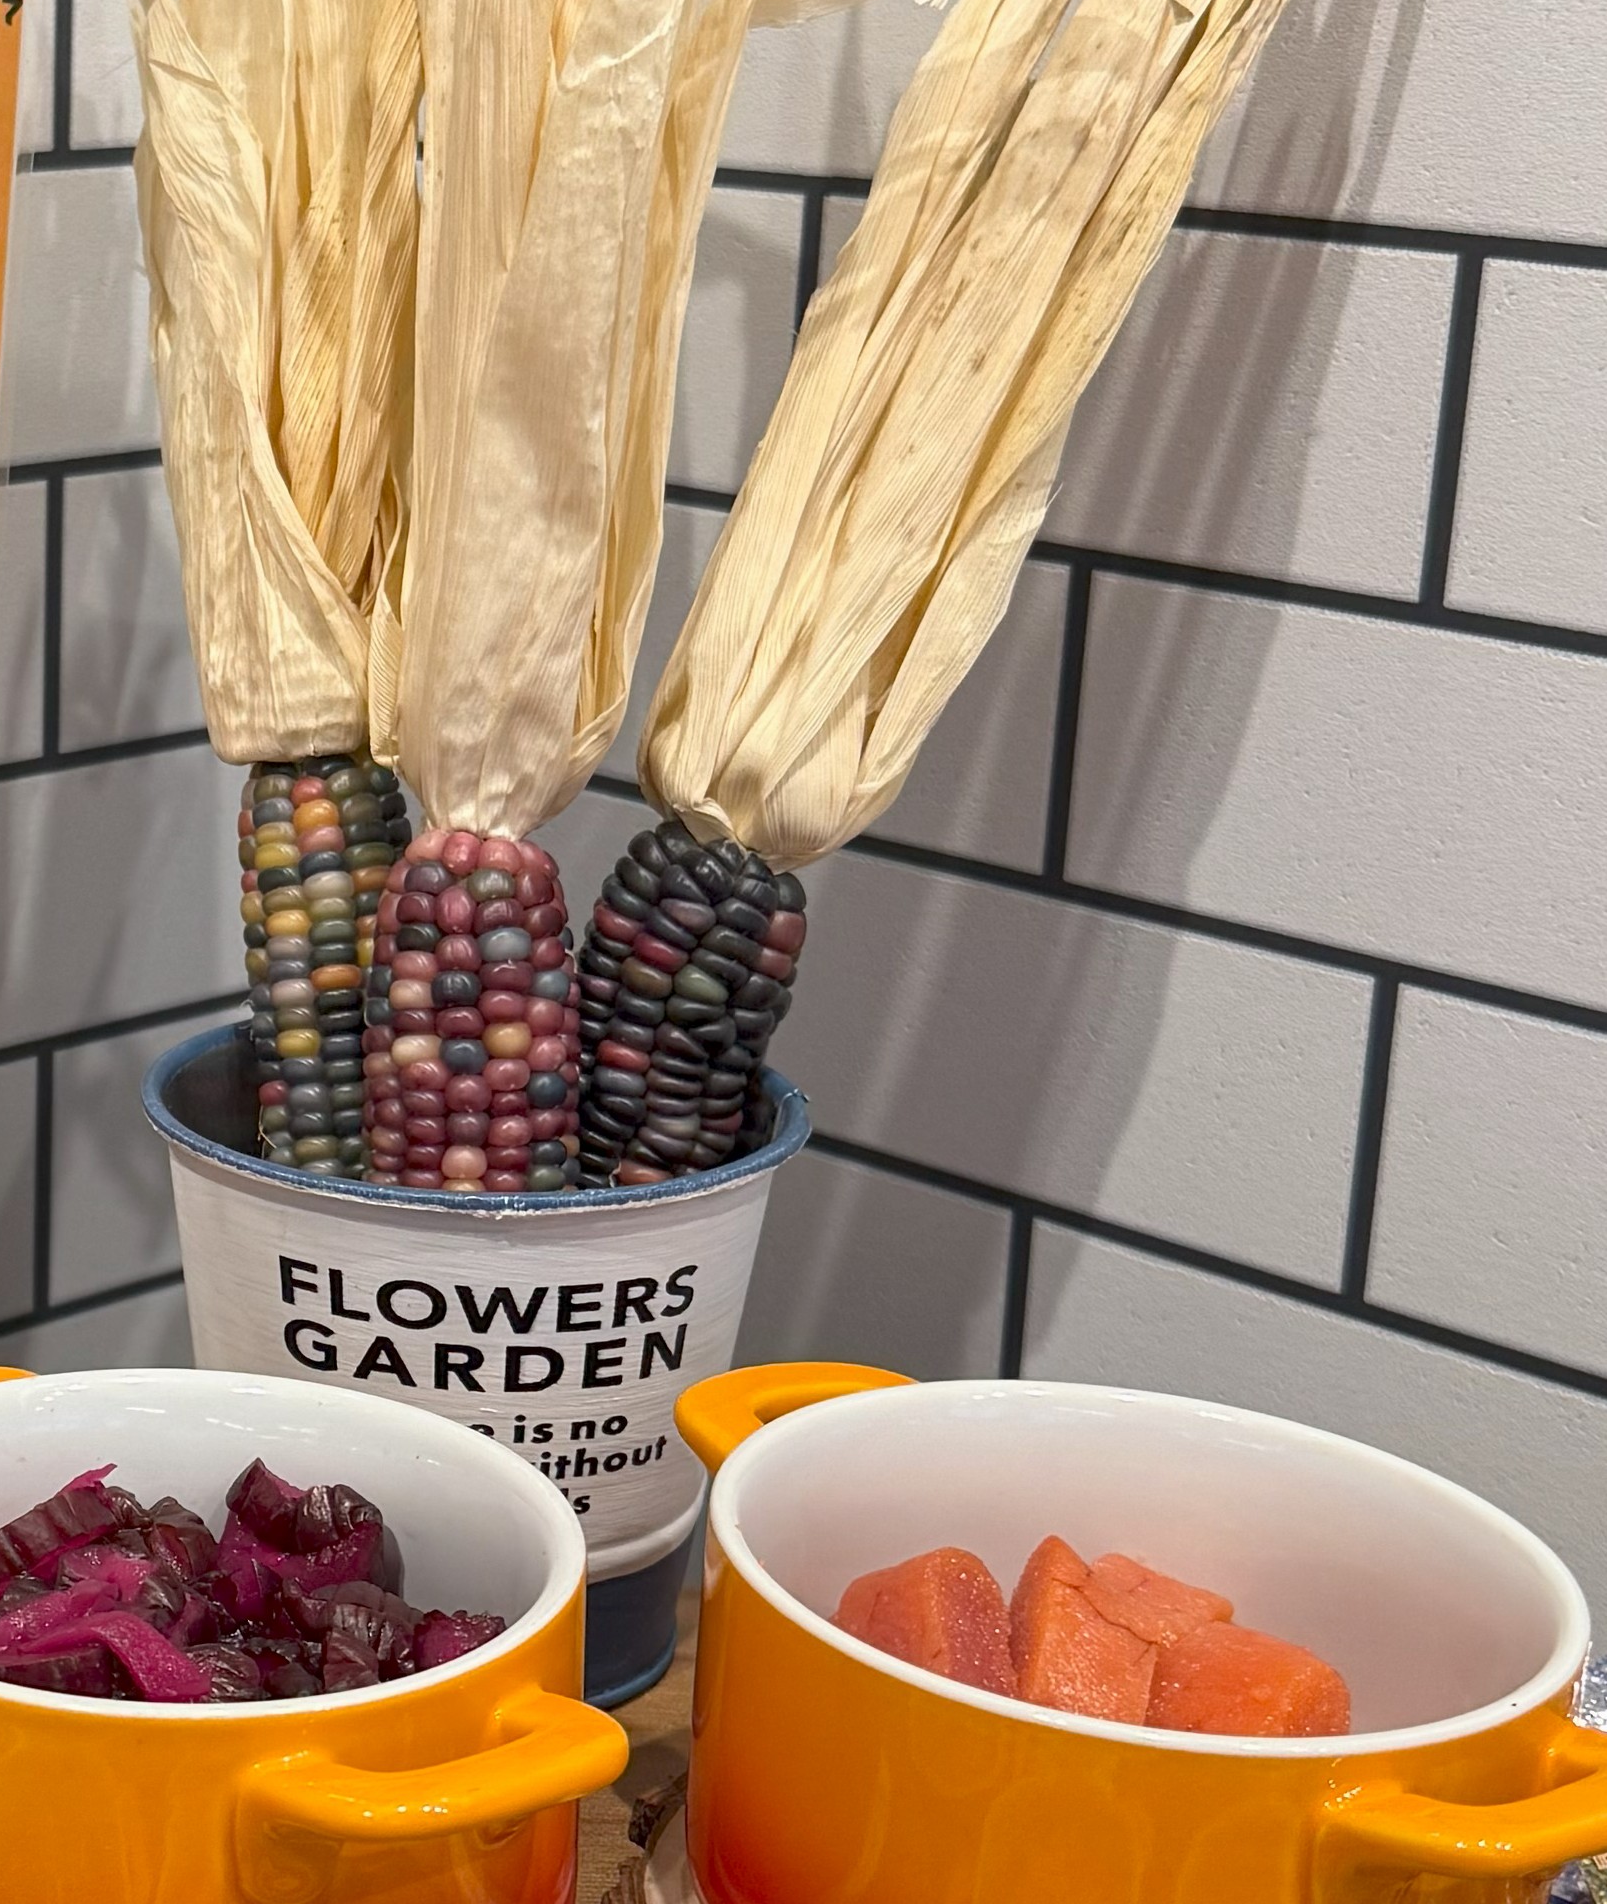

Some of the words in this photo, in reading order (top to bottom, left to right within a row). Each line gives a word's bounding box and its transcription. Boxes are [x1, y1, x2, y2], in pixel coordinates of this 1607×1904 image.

[278, 1256, 698, 1339] FLOWERS
[284, 1319, 688, 1393] GARDEN
[513, 1415, 553, 1444] is
[570, 1415, 629, 1440] no
[532, 1435, 667, 1480] ithout
